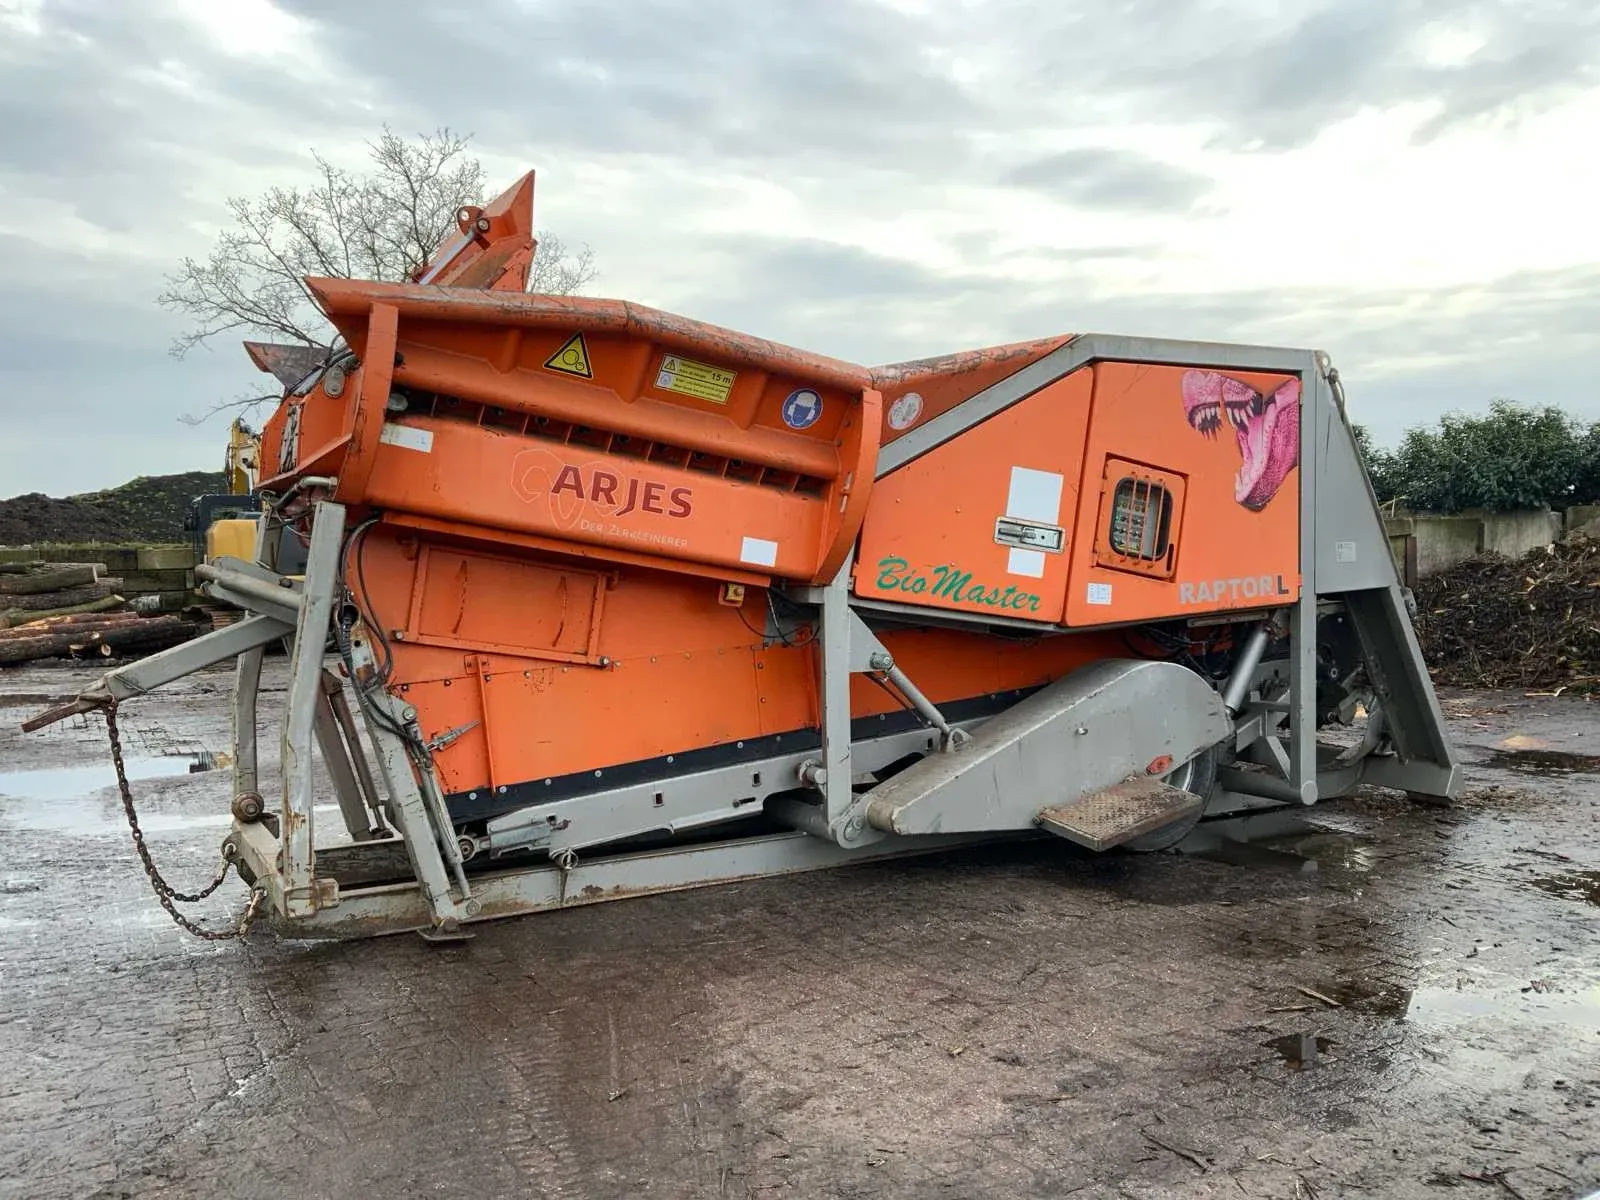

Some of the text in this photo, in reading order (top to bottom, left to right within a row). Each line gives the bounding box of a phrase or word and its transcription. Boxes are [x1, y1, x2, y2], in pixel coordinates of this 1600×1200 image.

[711, 372, 722, 382] 15
[722, 376, 731, 384] m
[551, 464, 692, 518] ARJES
[1179, 574, 1274, 604] RAPTOR
